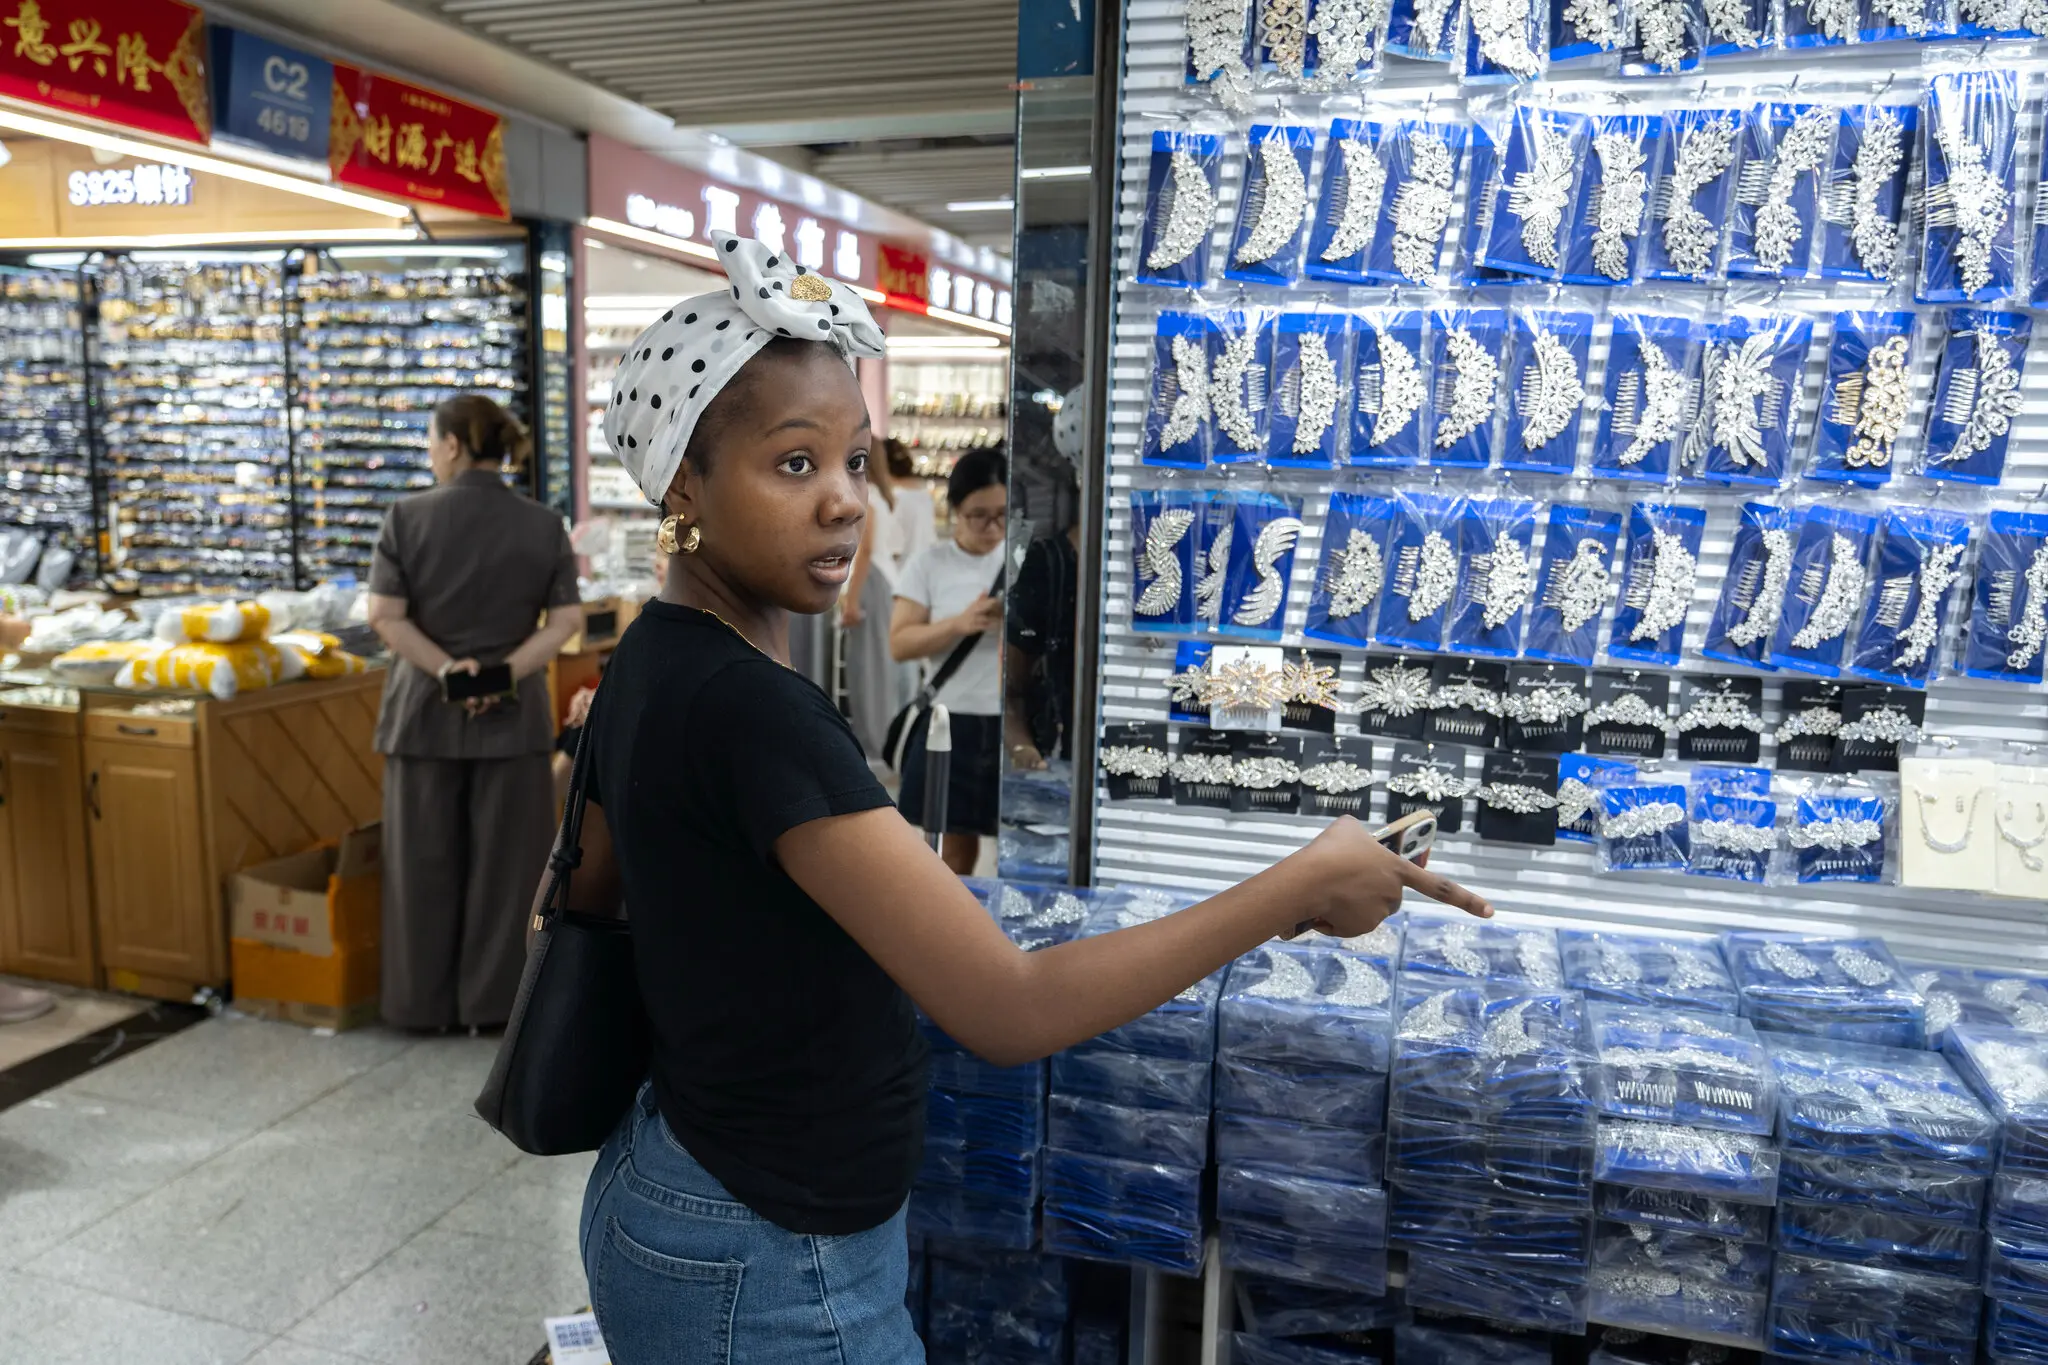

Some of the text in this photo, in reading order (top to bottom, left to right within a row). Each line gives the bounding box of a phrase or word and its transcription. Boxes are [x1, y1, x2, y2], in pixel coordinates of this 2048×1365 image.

[264, 55, 309, 101] C2
[257, 106, 310, 142] 4619
[1517, 677, 1547, 687] Fashion
[1701, 1109, 1716, 1117] MADE
[1724, 1113, 1743, 1122] CHINA
[1640, 1212, 1657, 1221] MADE
[1664, 1215, 1683, 1224] CHINA
